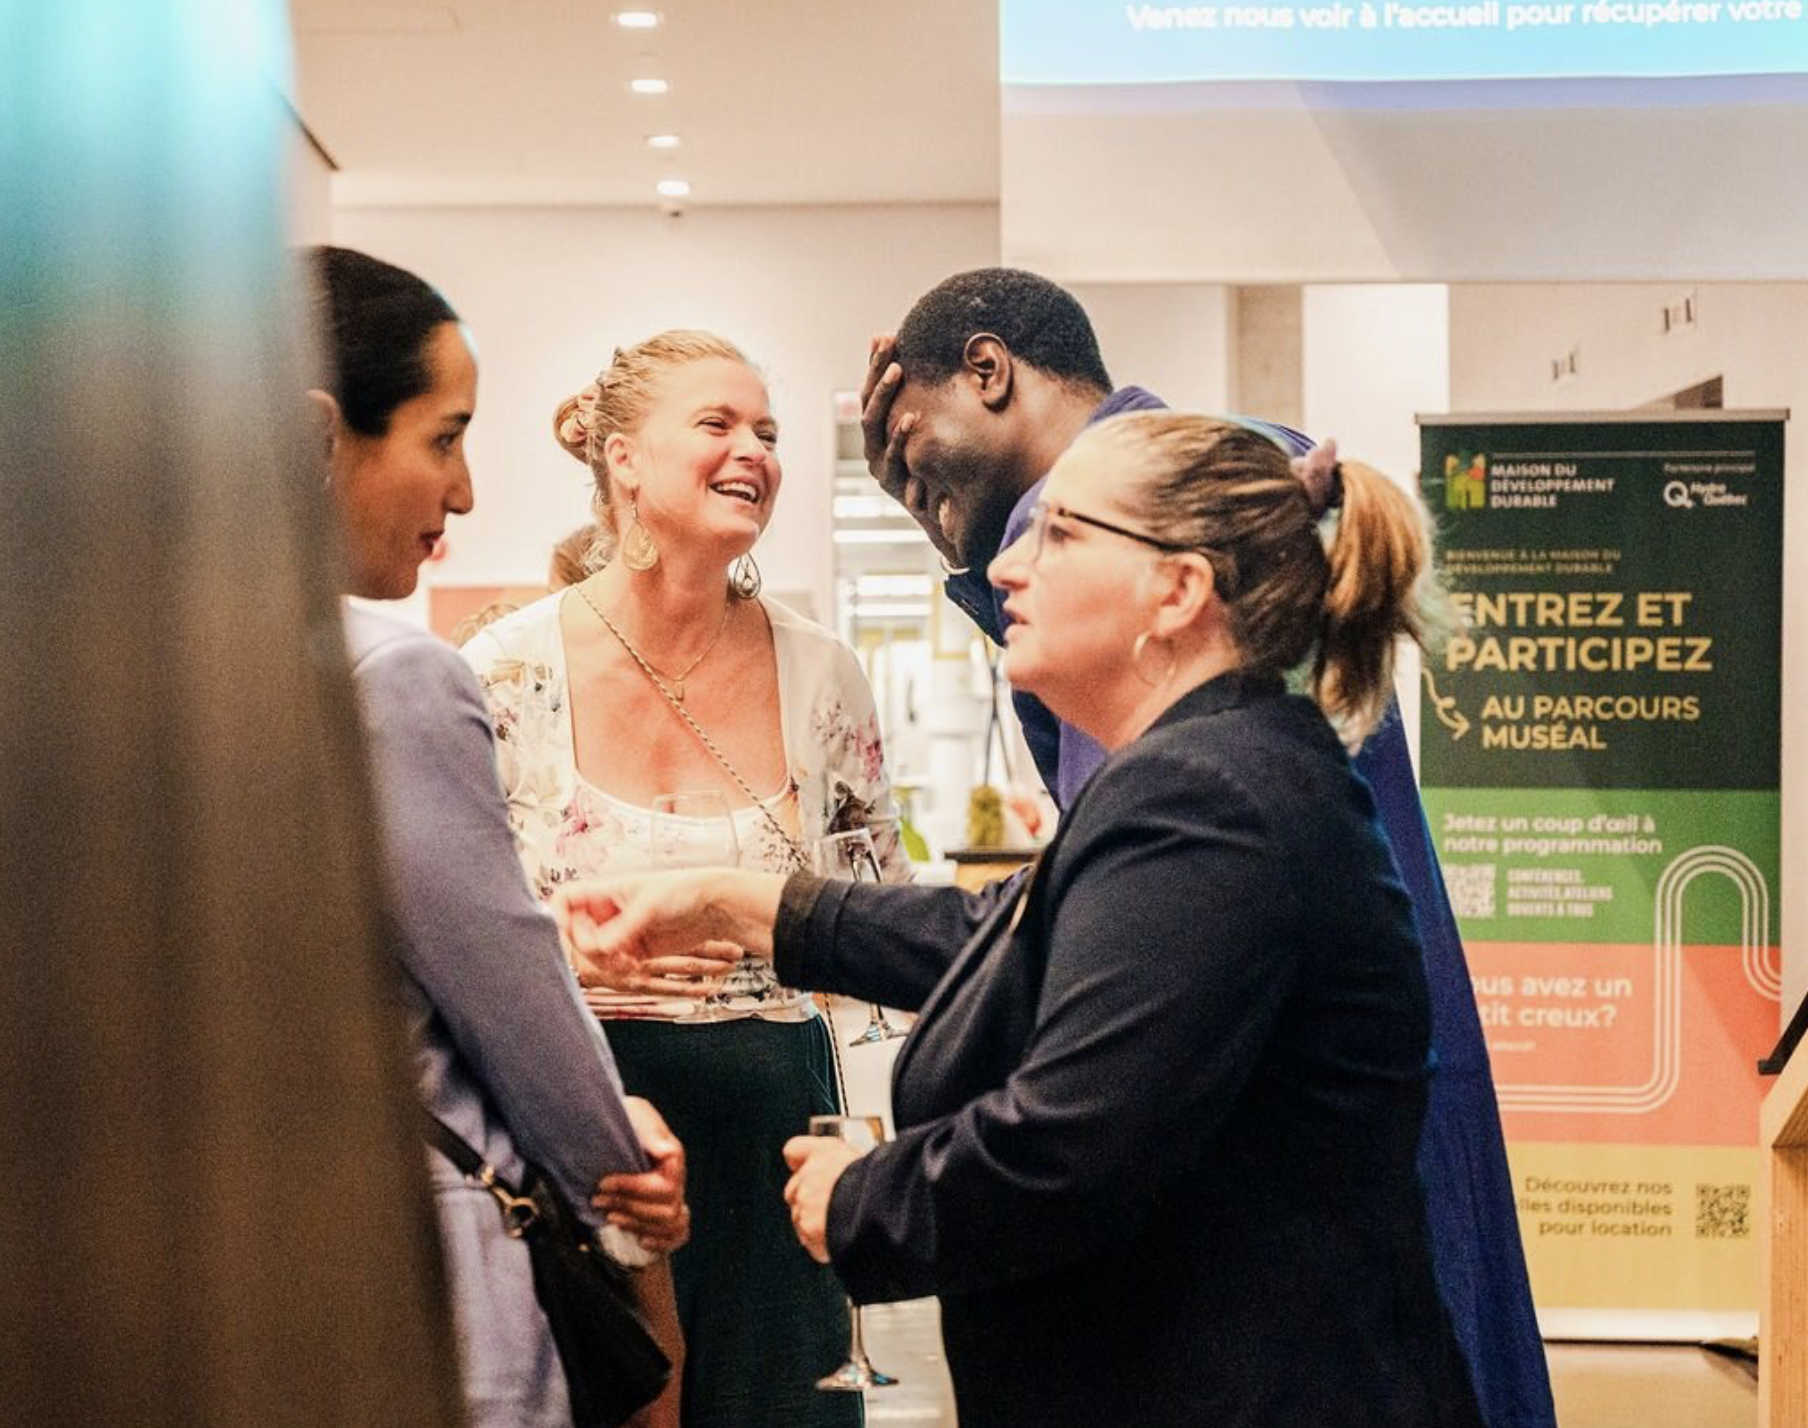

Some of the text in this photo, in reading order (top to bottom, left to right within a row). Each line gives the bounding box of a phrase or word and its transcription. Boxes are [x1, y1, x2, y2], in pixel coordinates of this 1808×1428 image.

[1127, 0, 1802, 31] Venez nous voir à l'accueil pour récupérer votre
[1491, 464, 1577, 476] MAISON DU
[1491, 495, 1557, 508] DURABLE
[1450, 593, 1692, 627] ENTREZ ET
[1446, 637, 1713, 671] PARTICIPEZ
[1482, 696, 1700, 720] AU PARCOURS
[1483, 720, 1607, 749] MUSÉAL
[1445, 814, 1497, 832] Jetez
[1501, 817, 1528, 831] un
[1533, 817, 1584, 834] coup
[1643, 815, 1655, 833] à
[1445, 836, 1662, 856] notre programmation
[1521, 976, 1588, 997] avez
[1595, 977, 1633, 997] un
[1480, 1003, 1618, 1027] tit creux?
[1525, 1176, 1673, 1195] Découvrez nos
[1557, 1200, 1673, 1216] disponibles
[1539, 1221, 1673, 1237] pour location
